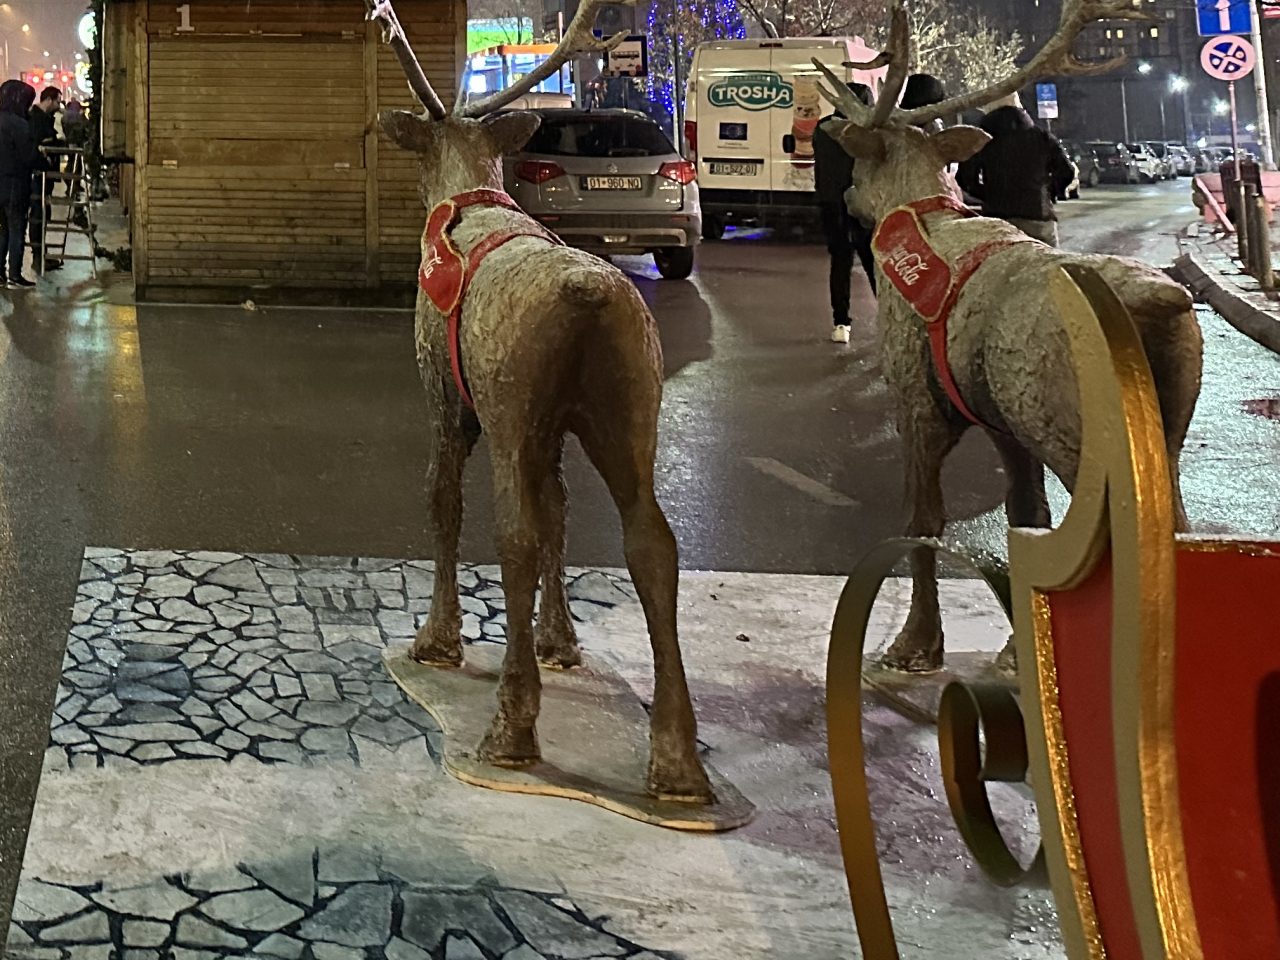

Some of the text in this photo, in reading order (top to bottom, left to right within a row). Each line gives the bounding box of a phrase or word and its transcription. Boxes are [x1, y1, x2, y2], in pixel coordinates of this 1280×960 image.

[176, 4, 194, 31] 1
[715, 86, 790, 104] TROSHA
[590, 178, 601, 188] 01
[607, 178, 624, 188] 960
